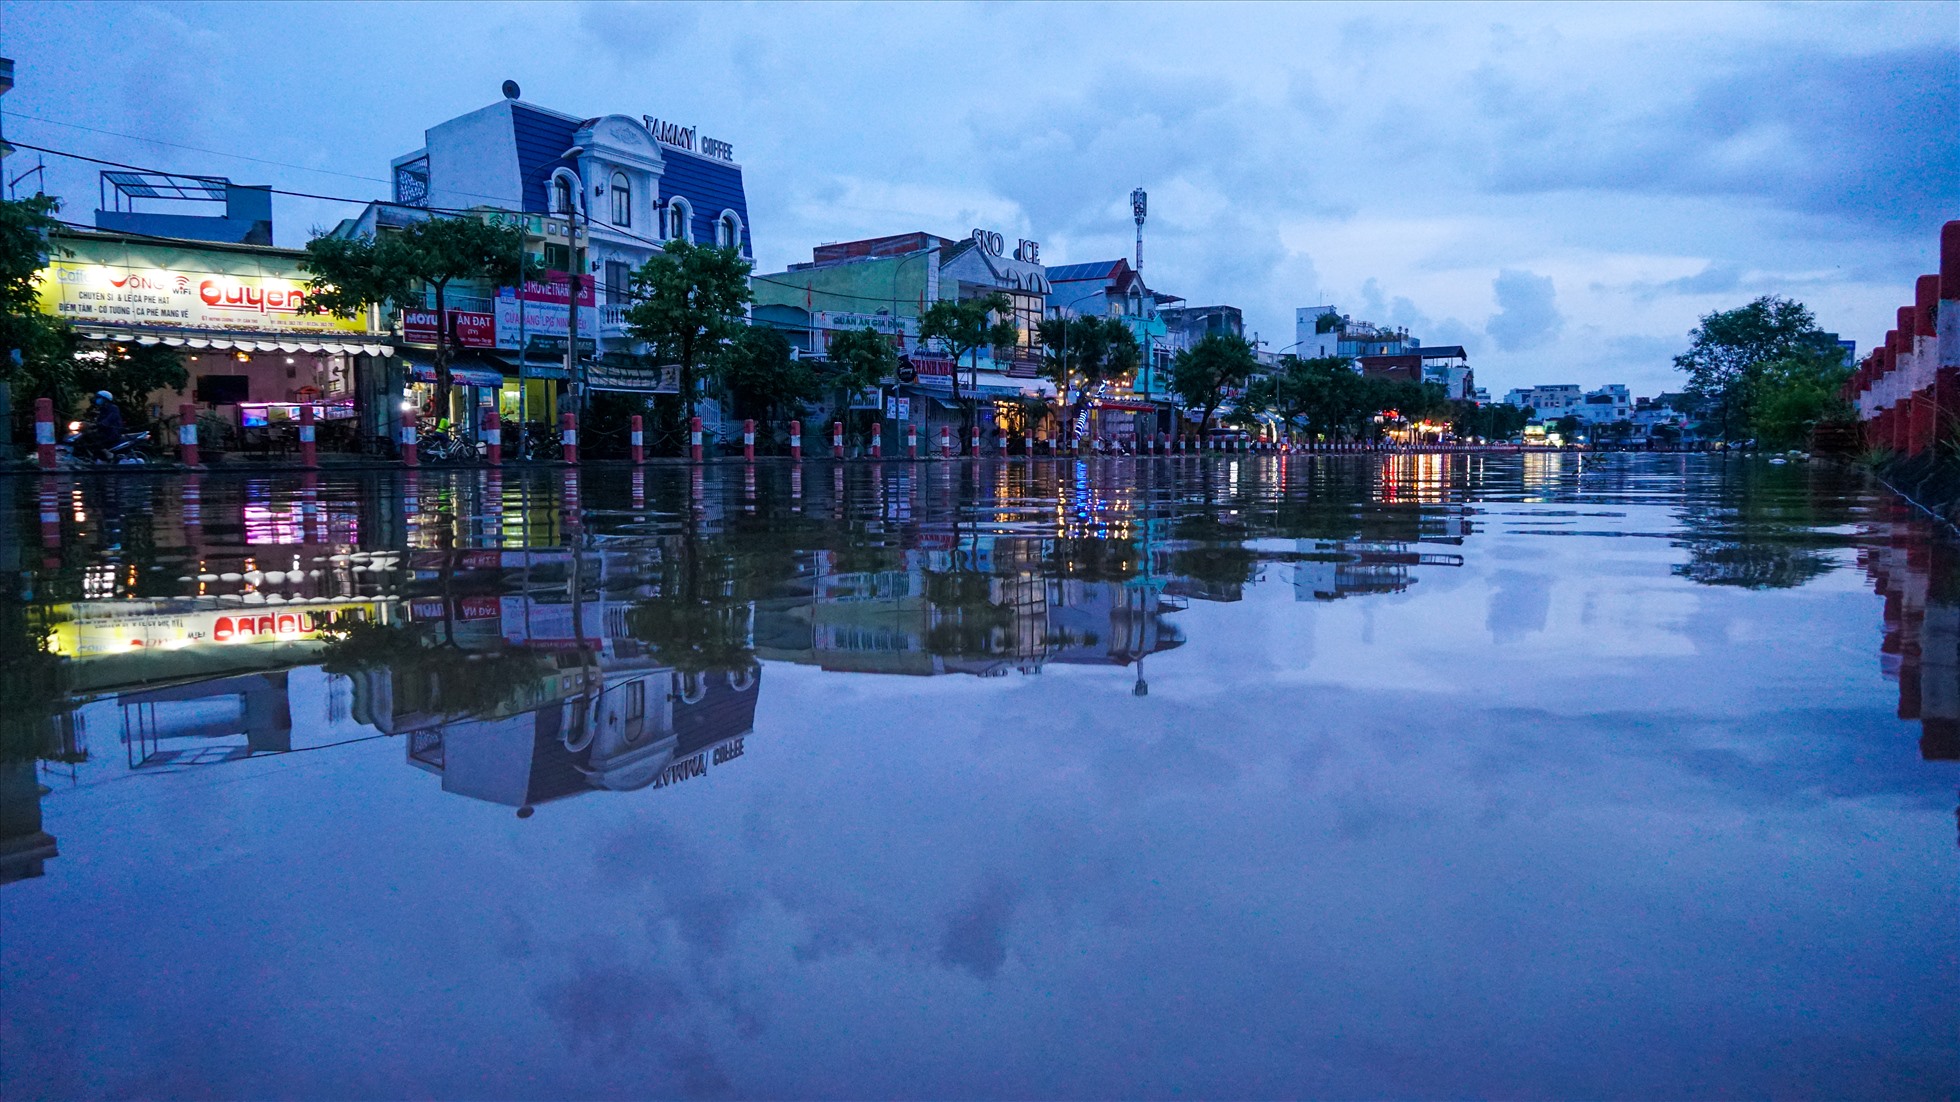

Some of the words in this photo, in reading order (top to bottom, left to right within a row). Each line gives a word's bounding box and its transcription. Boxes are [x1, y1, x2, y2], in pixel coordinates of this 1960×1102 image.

[643, 115, 694, 150] TAMMY
[701, 136, 733, 161] COFFEE
[972, 228, 1004, 257] SNO
[1018, 238, 1040, 265] ICE
[161, 308, 180, 319] MANG
